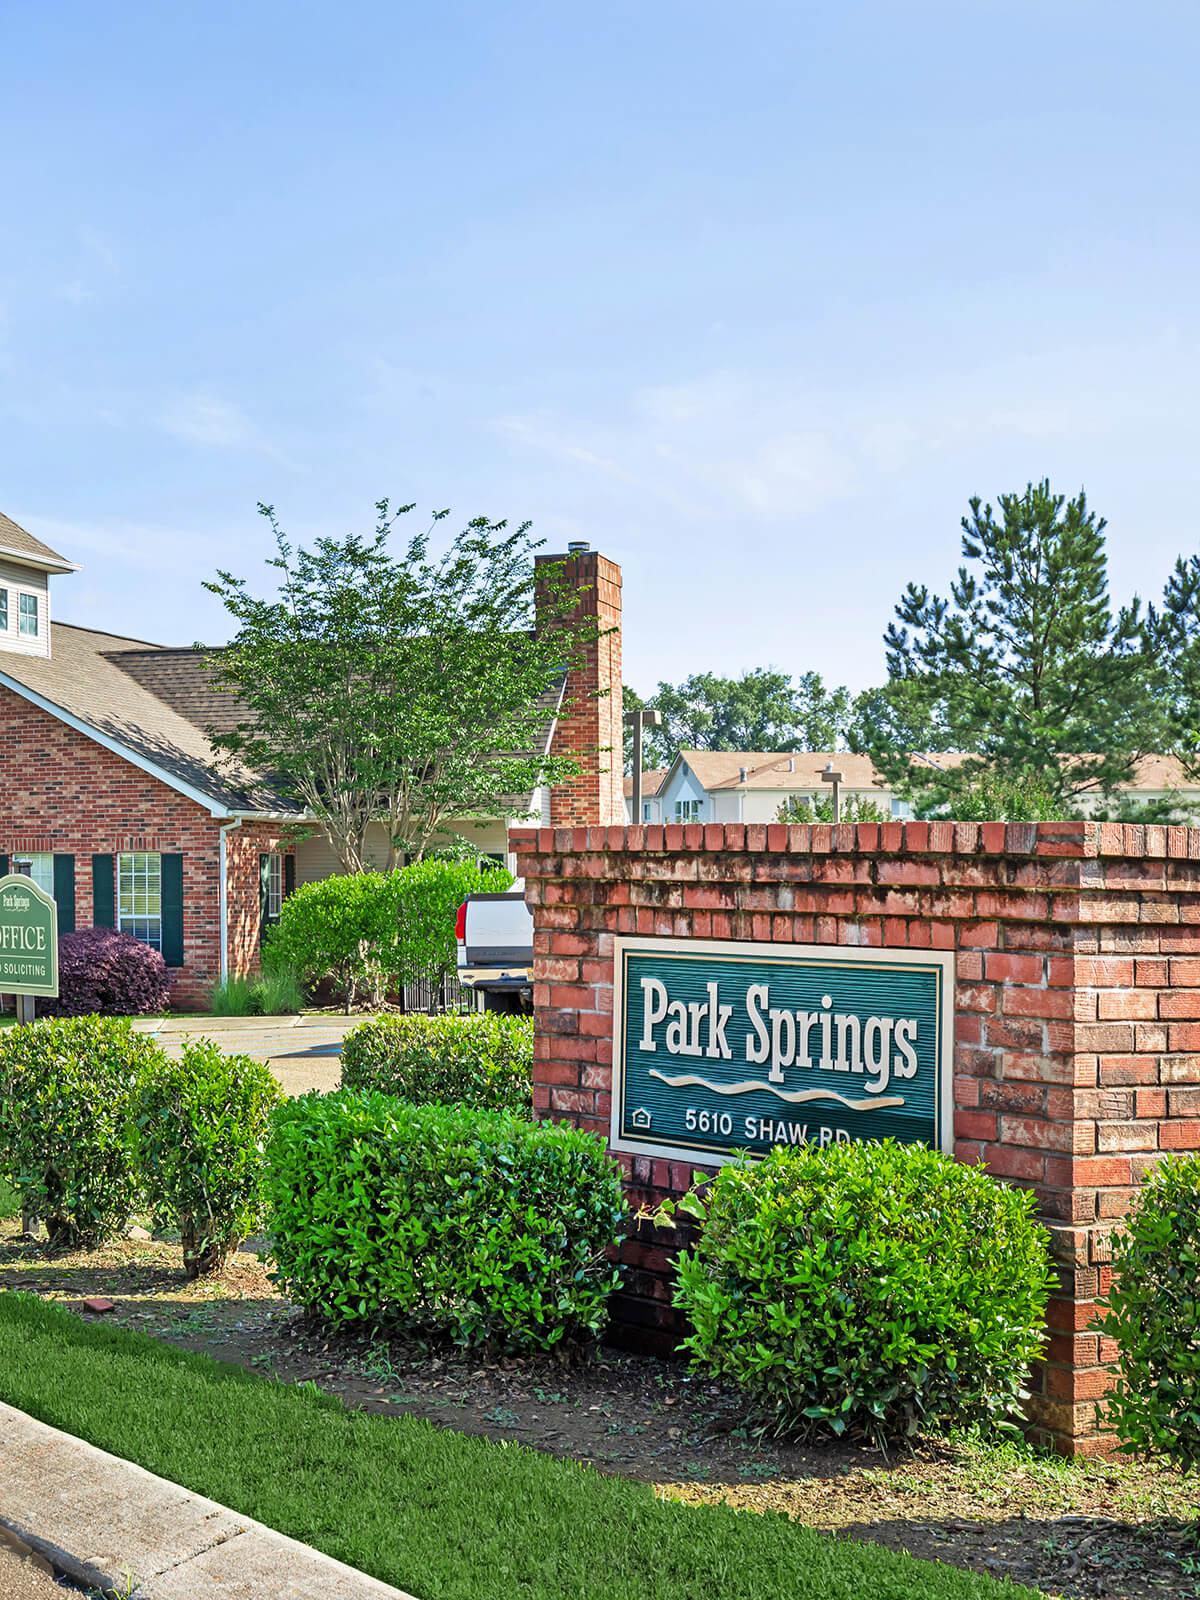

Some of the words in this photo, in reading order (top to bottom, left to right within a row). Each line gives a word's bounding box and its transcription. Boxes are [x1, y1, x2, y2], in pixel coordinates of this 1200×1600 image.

[4, 963, 46, 976] SOLICITING
[639, 977, 733, 1060] Park
[746, 984, 918, 1093] Springs
[685, 1108, 732, 1135] 5610
[744, 1116, 808, 1146] SHAW
